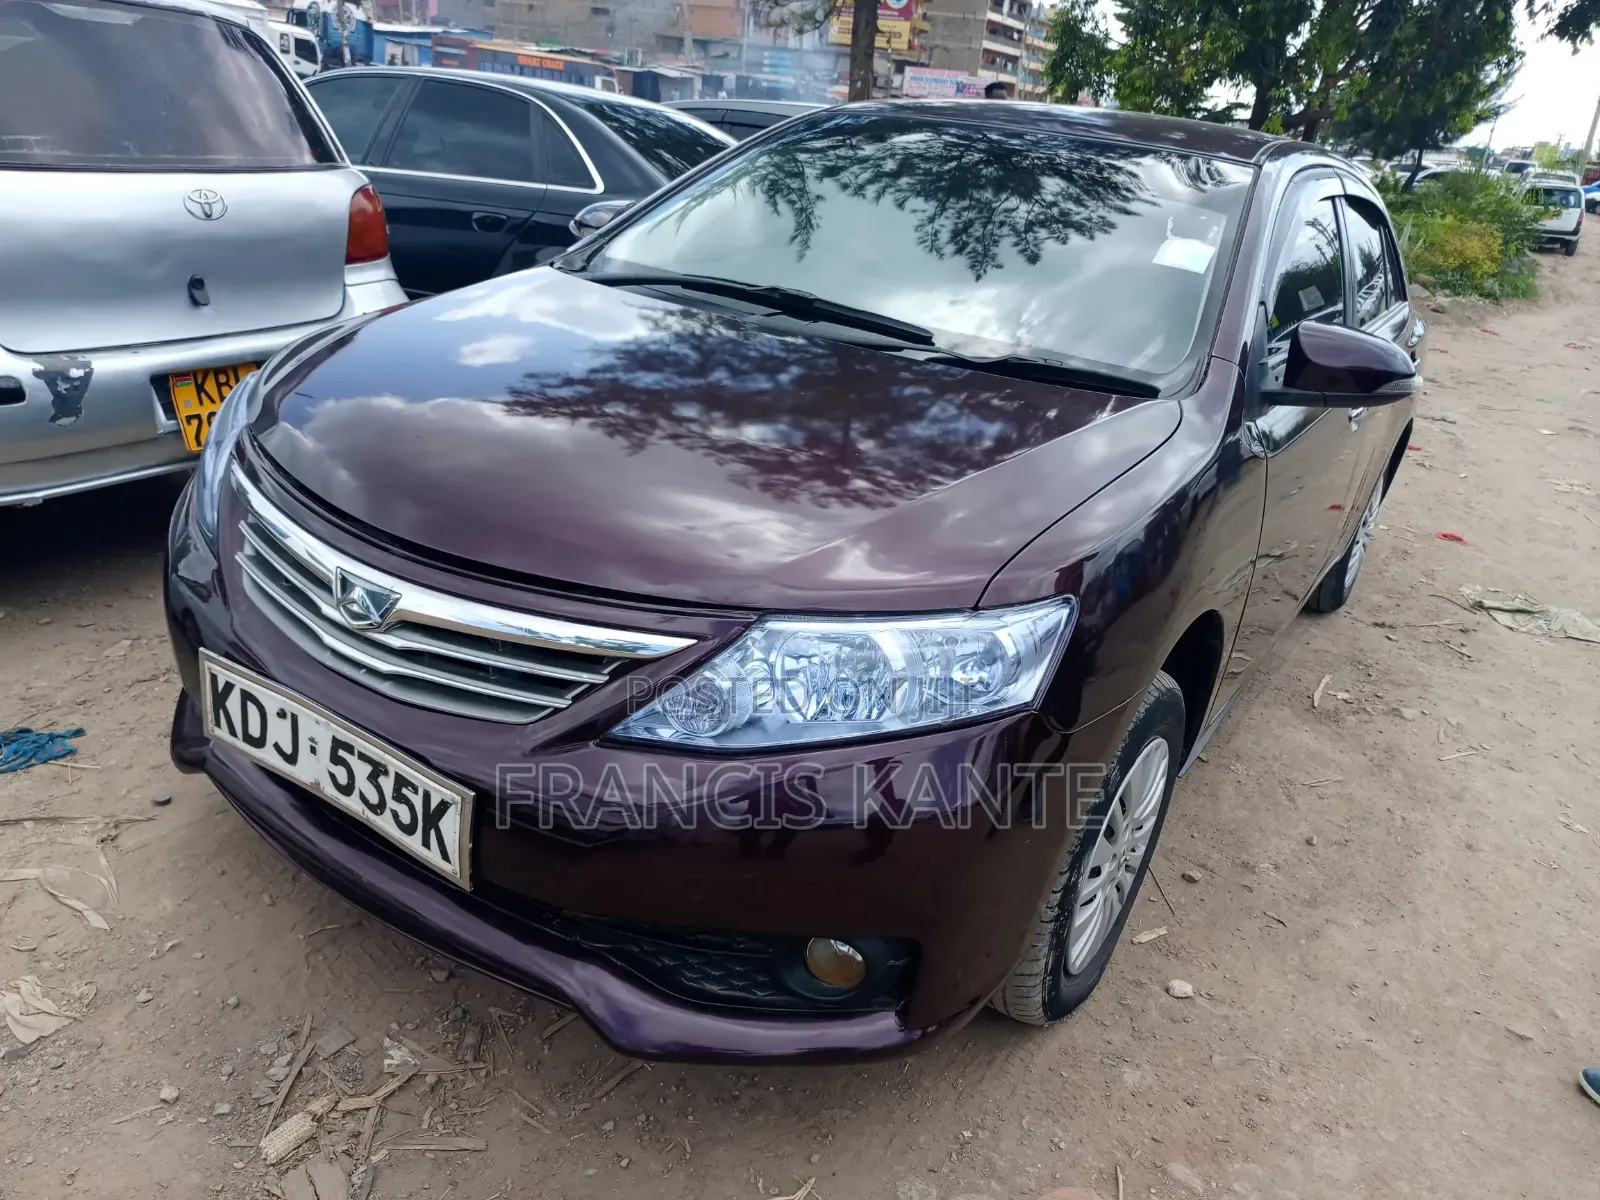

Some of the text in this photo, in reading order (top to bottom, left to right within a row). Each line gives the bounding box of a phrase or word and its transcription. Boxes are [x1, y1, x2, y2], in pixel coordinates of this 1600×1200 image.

[542, 59, 564, 70] COACH
[210, 672, 453, 864] KDJ 535K
